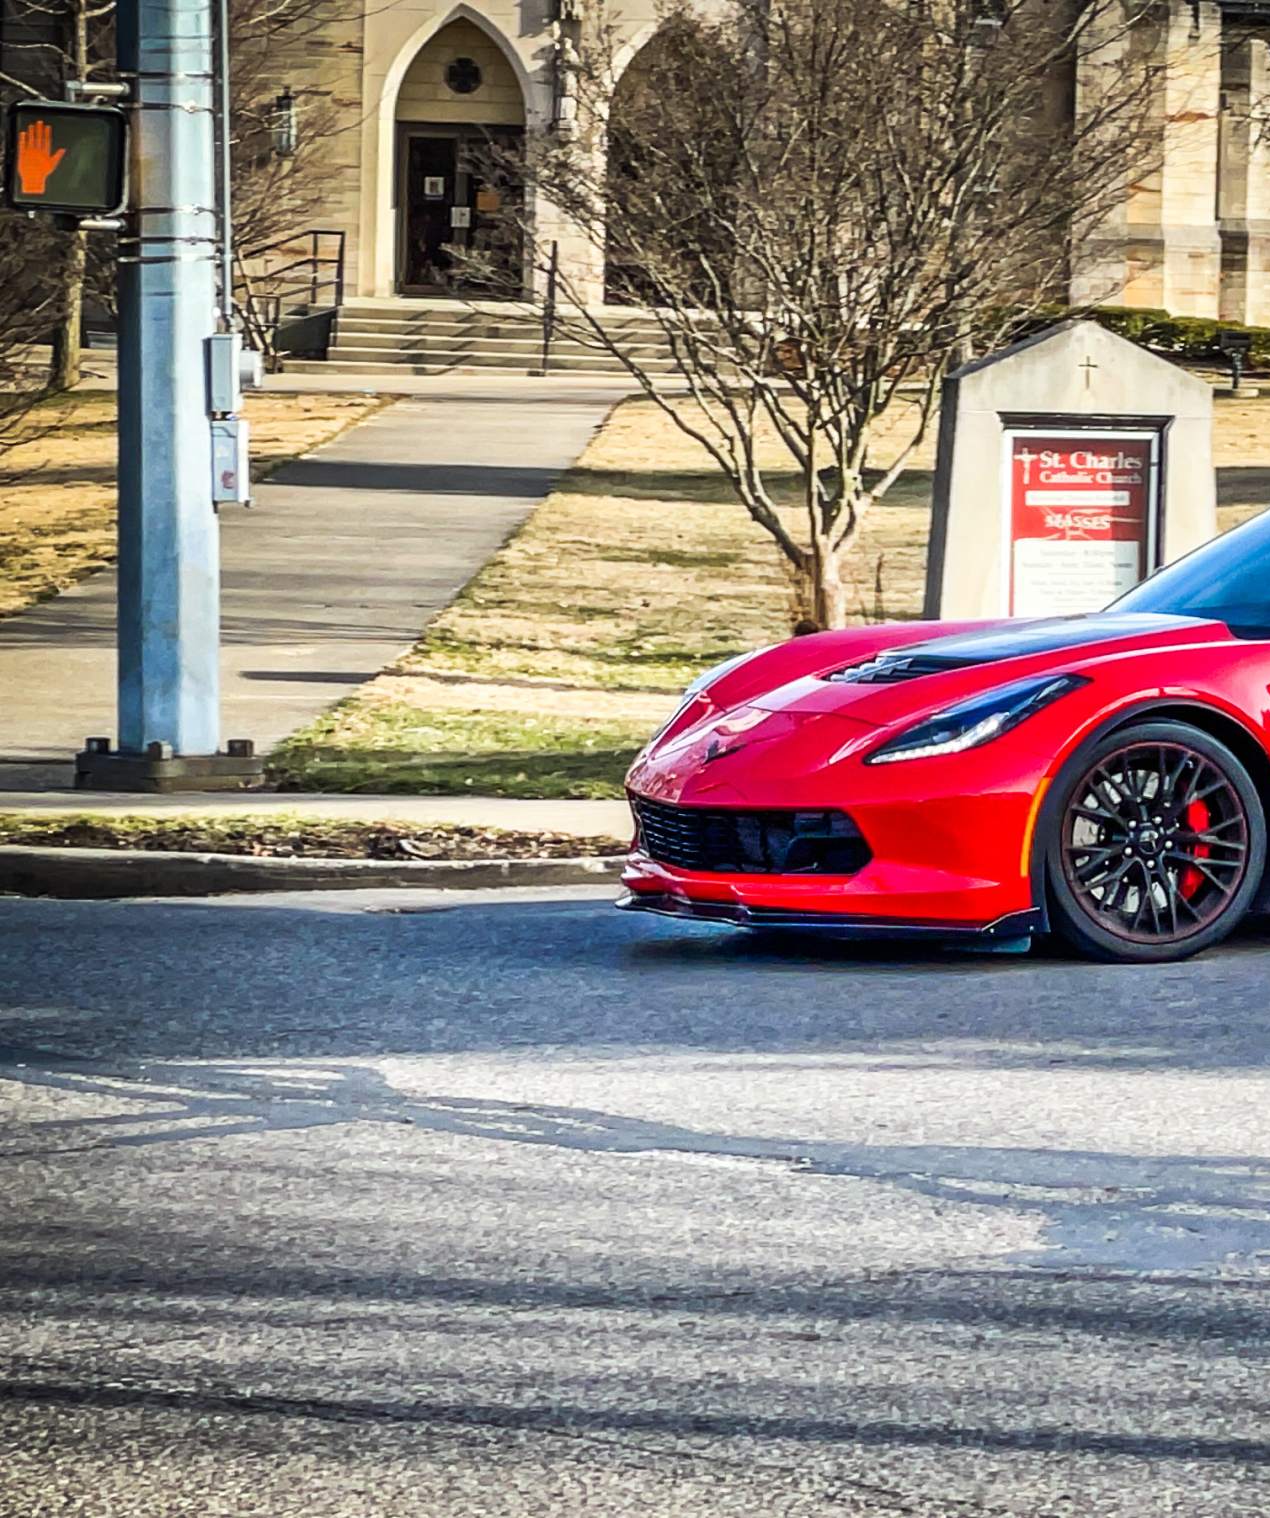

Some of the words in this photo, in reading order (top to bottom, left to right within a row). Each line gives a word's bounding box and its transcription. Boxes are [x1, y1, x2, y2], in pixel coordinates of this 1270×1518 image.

[1039, 451, 1065, 469] St.
[1069, 451, 1142, 469] Charles
[1039, 471, 1094, 483] Catholic
